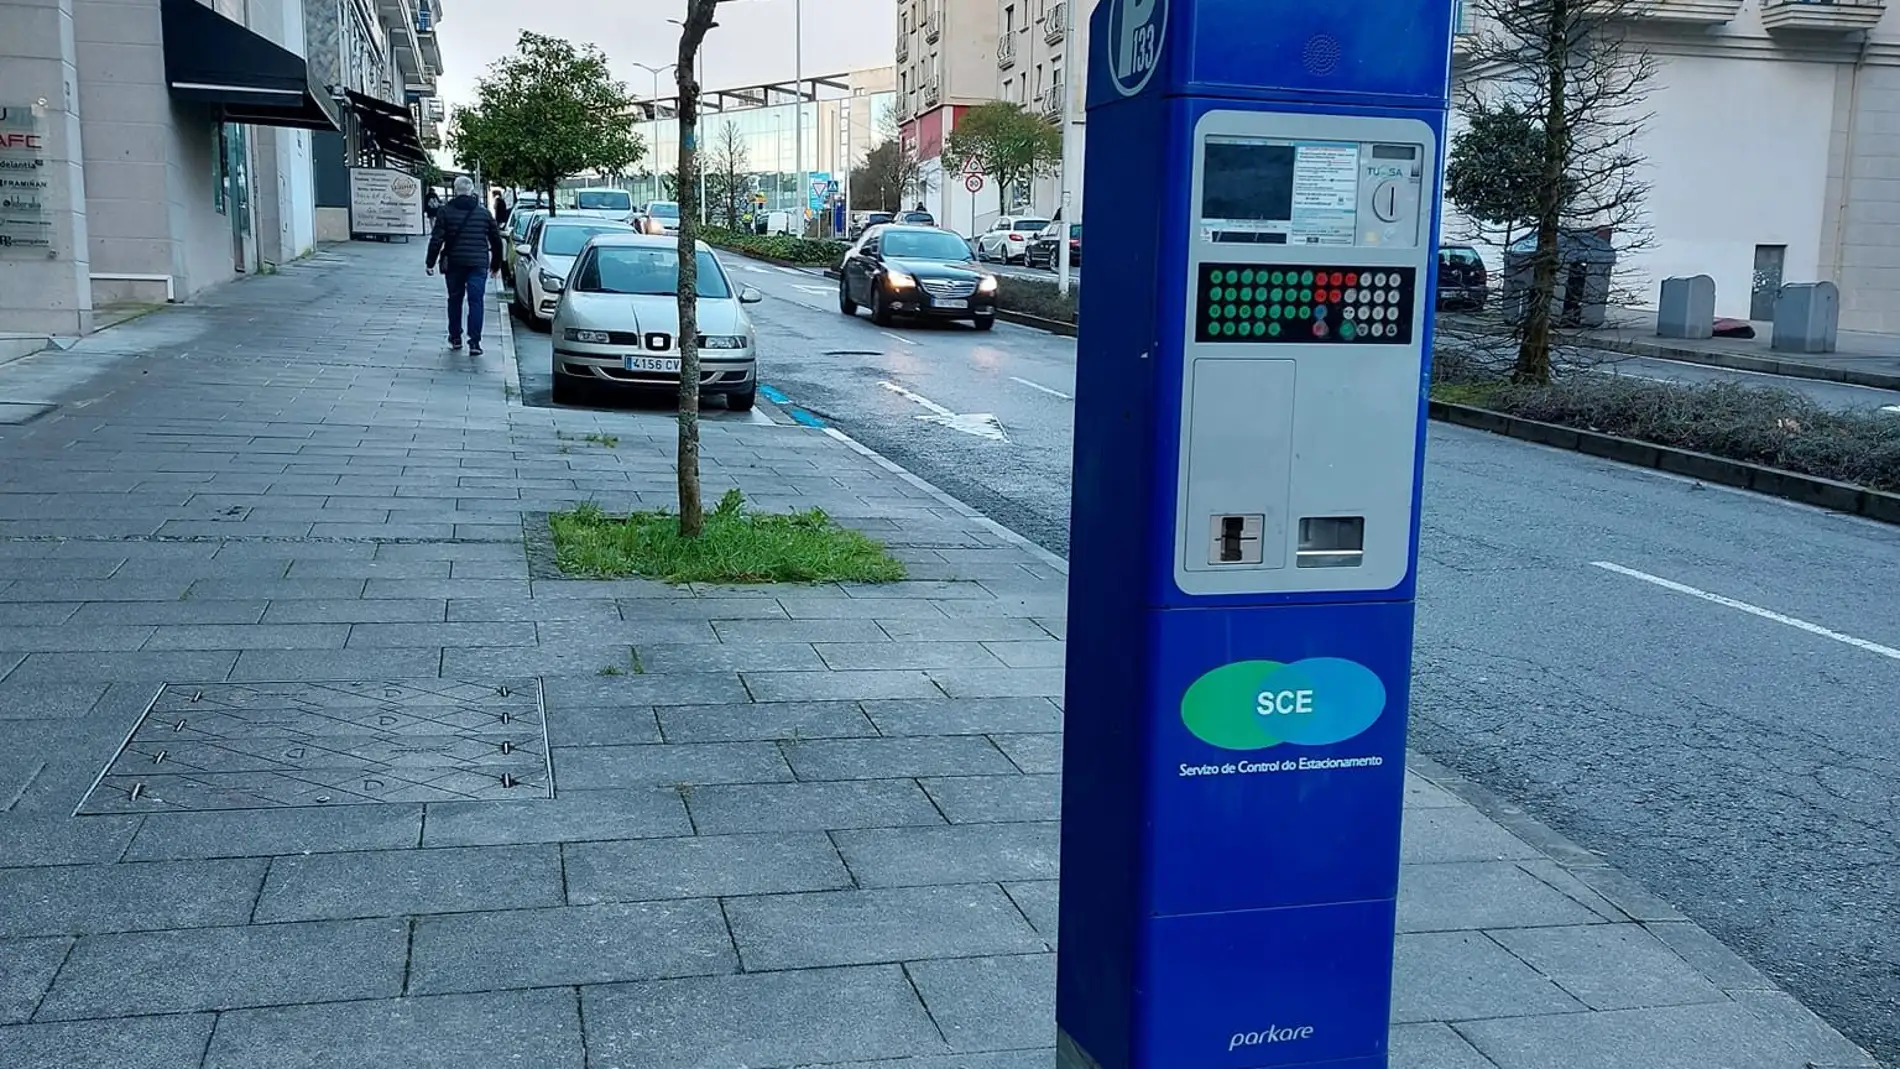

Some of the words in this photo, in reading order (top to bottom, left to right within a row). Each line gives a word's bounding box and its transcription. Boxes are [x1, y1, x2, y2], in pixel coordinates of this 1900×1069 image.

[1118, 0, 1155, 79] P
[1132, 24, 1155, 73] 133
[633, 358, 662, 370] 4156
[666, 360, 680, 370] CV
[1257, 689, 1313, 715] SCE
[1179, 763, 1219, 777] Servizo
[1221, 762, 1236, 774] de
[1238, 760, 1280, 773] Control
[1282, 759, 1297, 771] do
[1299, 756, 1383, 770] Estacionamento
[1228, 1024, 1314, 1051] parkare
